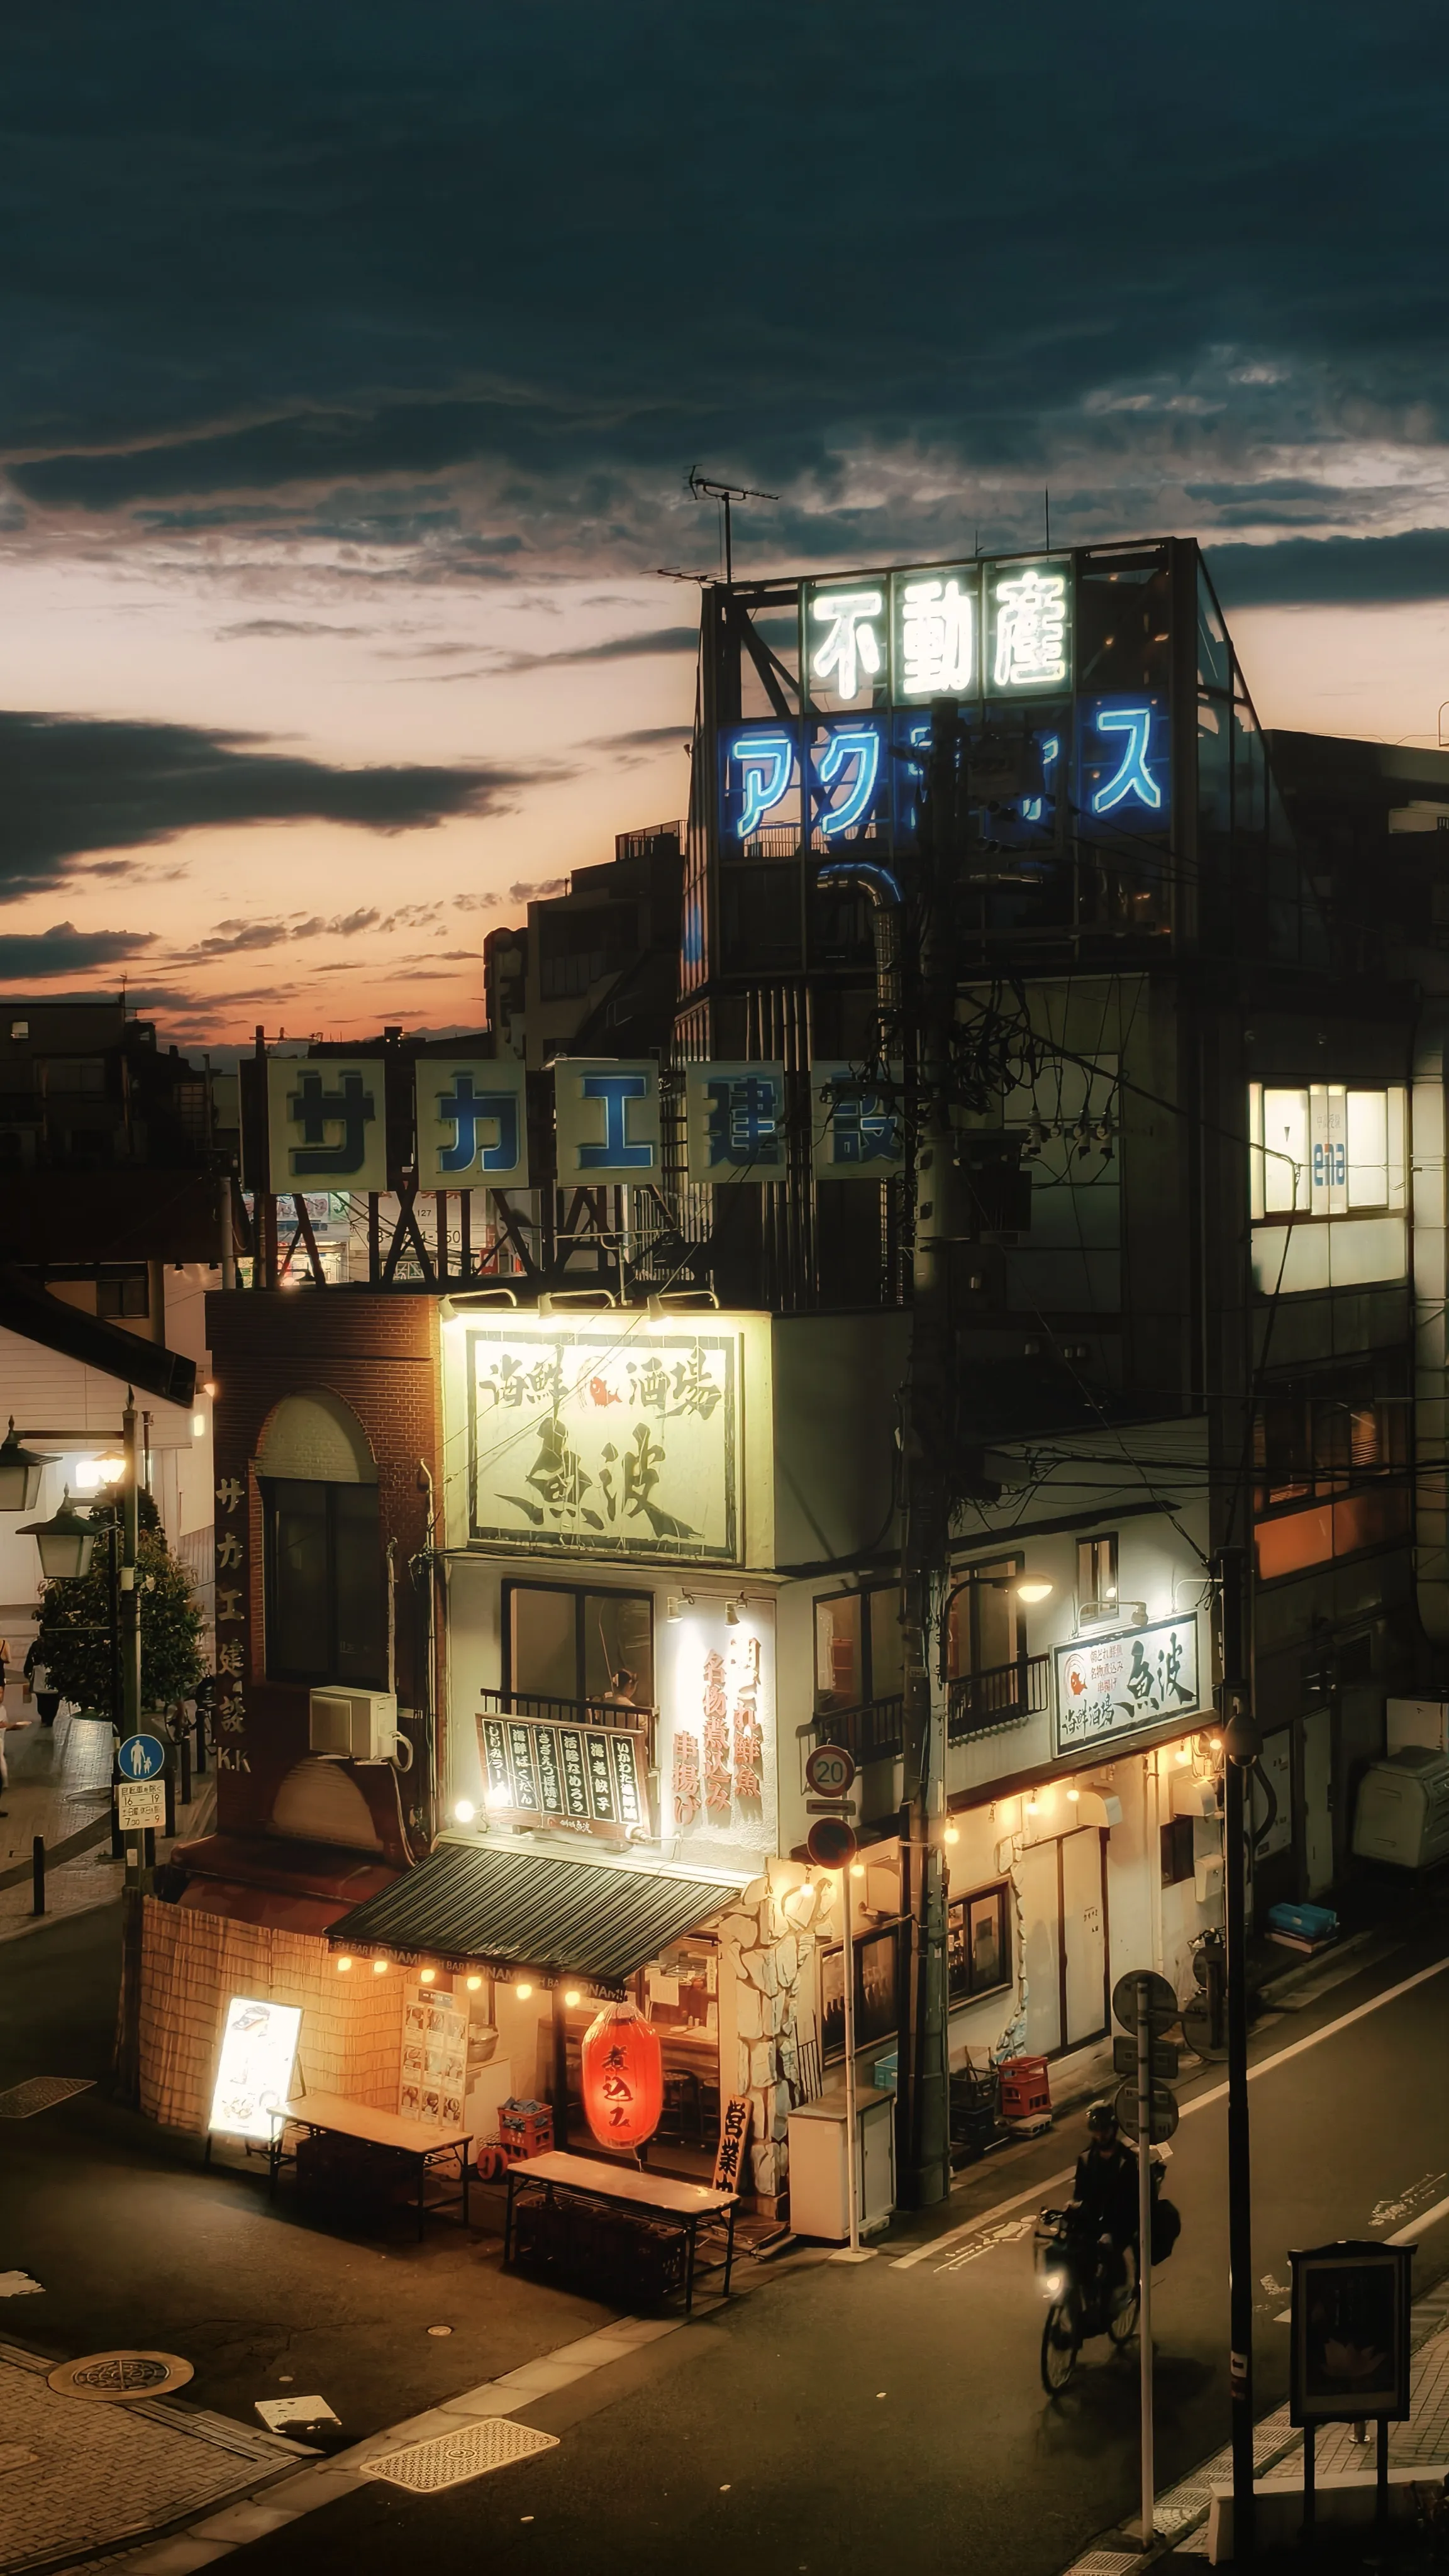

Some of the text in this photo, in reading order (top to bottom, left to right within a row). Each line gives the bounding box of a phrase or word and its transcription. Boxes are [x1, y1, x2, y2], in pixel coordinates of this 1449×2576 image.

[813, 570, 1067, 700] 不動産
[732, 708, 1161, 840] アクス
[287, 1069, 902, 1175] サカエ建設
[1314, 1143, 1345, 1186] ena
[494, 1417, 705, 1539] 魚波
[216, 1477, 245, 1734] サカエ建設
[702, 1649, 732, 1813] 名物煮込み
[730, 1637, 762, 1798] れ鮮魚
[1112, 1631, 1197, 1718] 魚波
[488, 1725, 511, 1804] しじみラー
[672, 1730, 701, 1825] 串揚げ
[817, 1761, 843, 1783] 20
